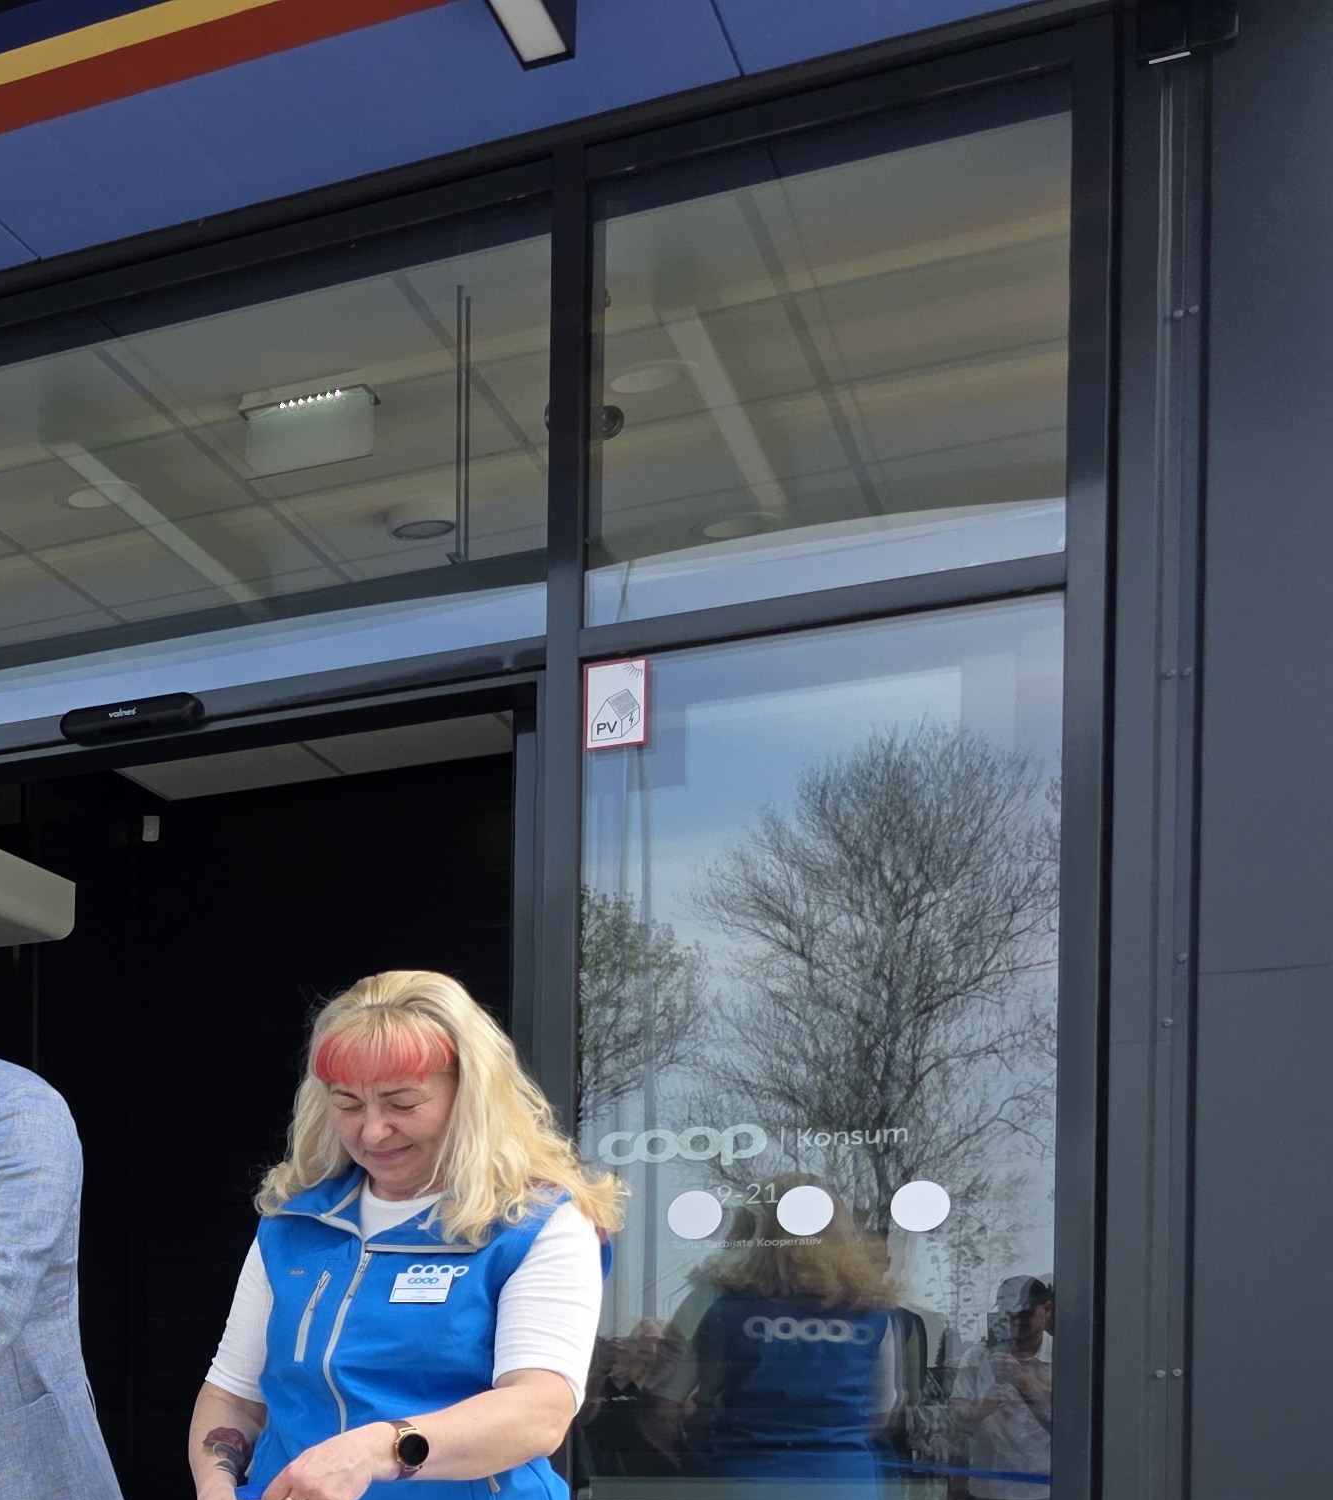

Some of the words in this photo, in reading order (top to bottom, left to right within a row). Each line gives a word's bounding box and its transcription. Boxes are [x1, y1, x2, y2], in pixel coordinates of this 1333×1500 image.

[597, 720, 618, 735] PV
[598, 1123, 767, 1166] coop
[796, 1126, 909, 1148] Konsum
[407, 1264, 469, 1278] coop
[407, 1277, 440, 1285] coop
